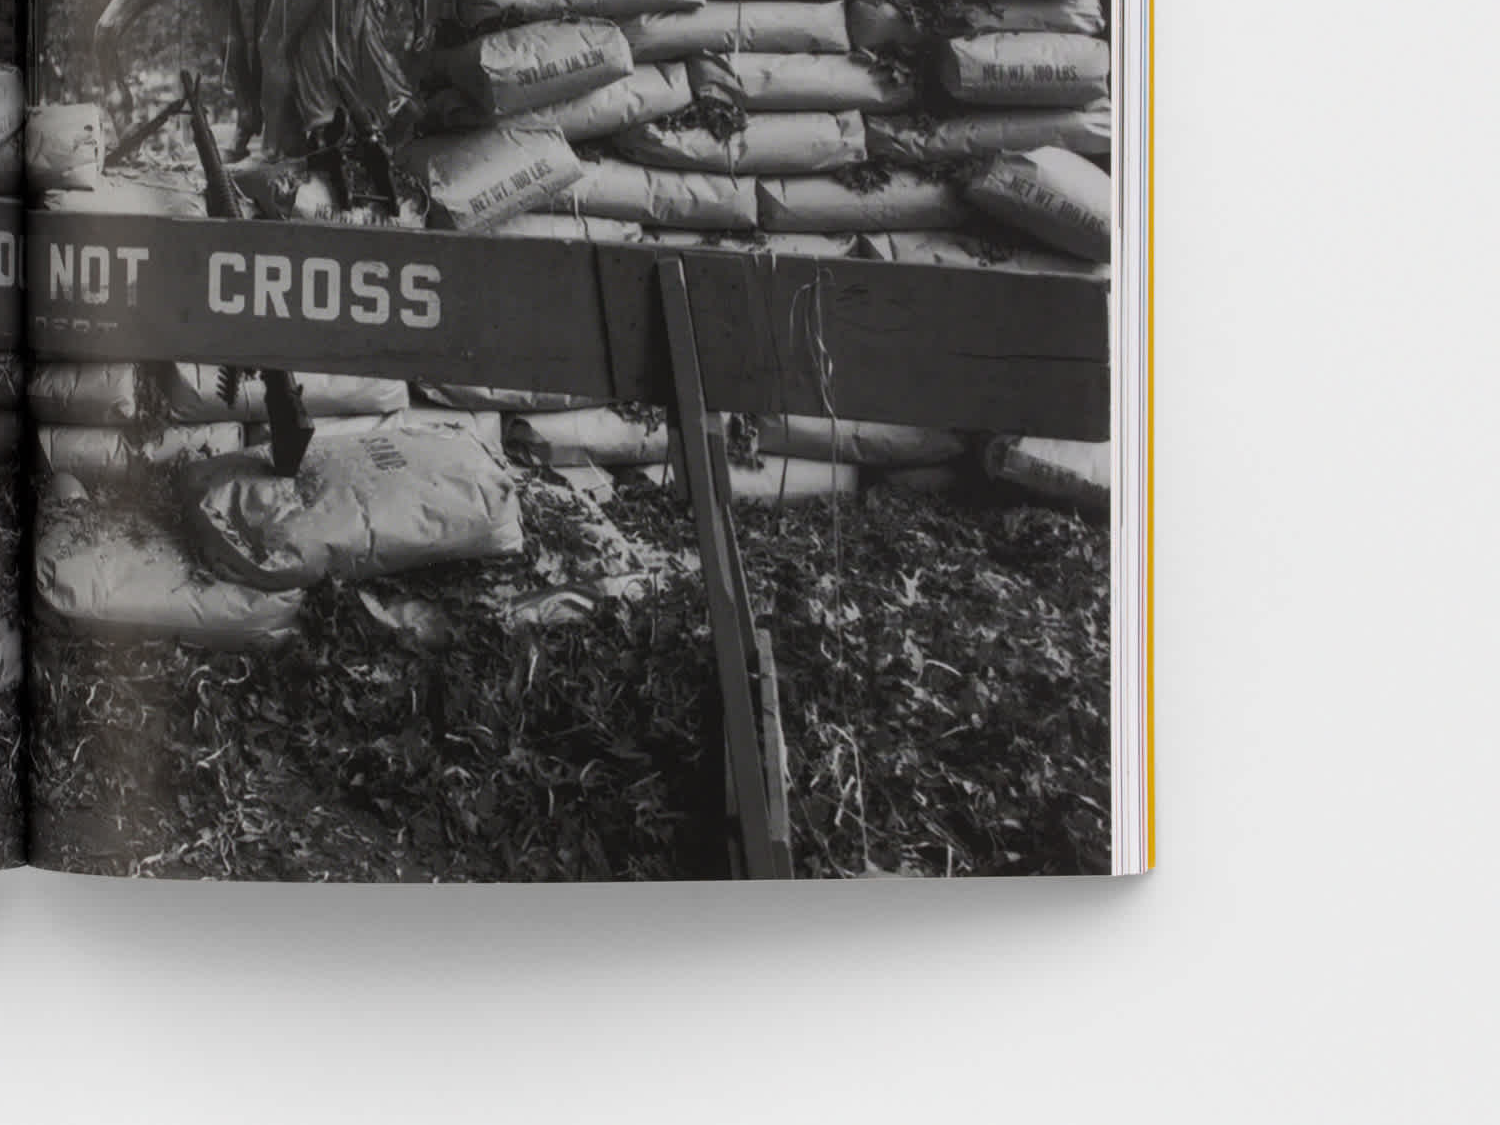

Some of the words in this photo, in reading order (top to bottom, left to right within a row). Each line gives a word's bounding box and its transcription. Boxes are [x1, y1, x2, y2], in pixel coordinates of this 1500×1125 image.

[469, 189, 491, 213] NET
[509, 169, 532, 191] 100
[50, 242, 149, 307] NOT
[208, 251, 442, 329] CROSS
